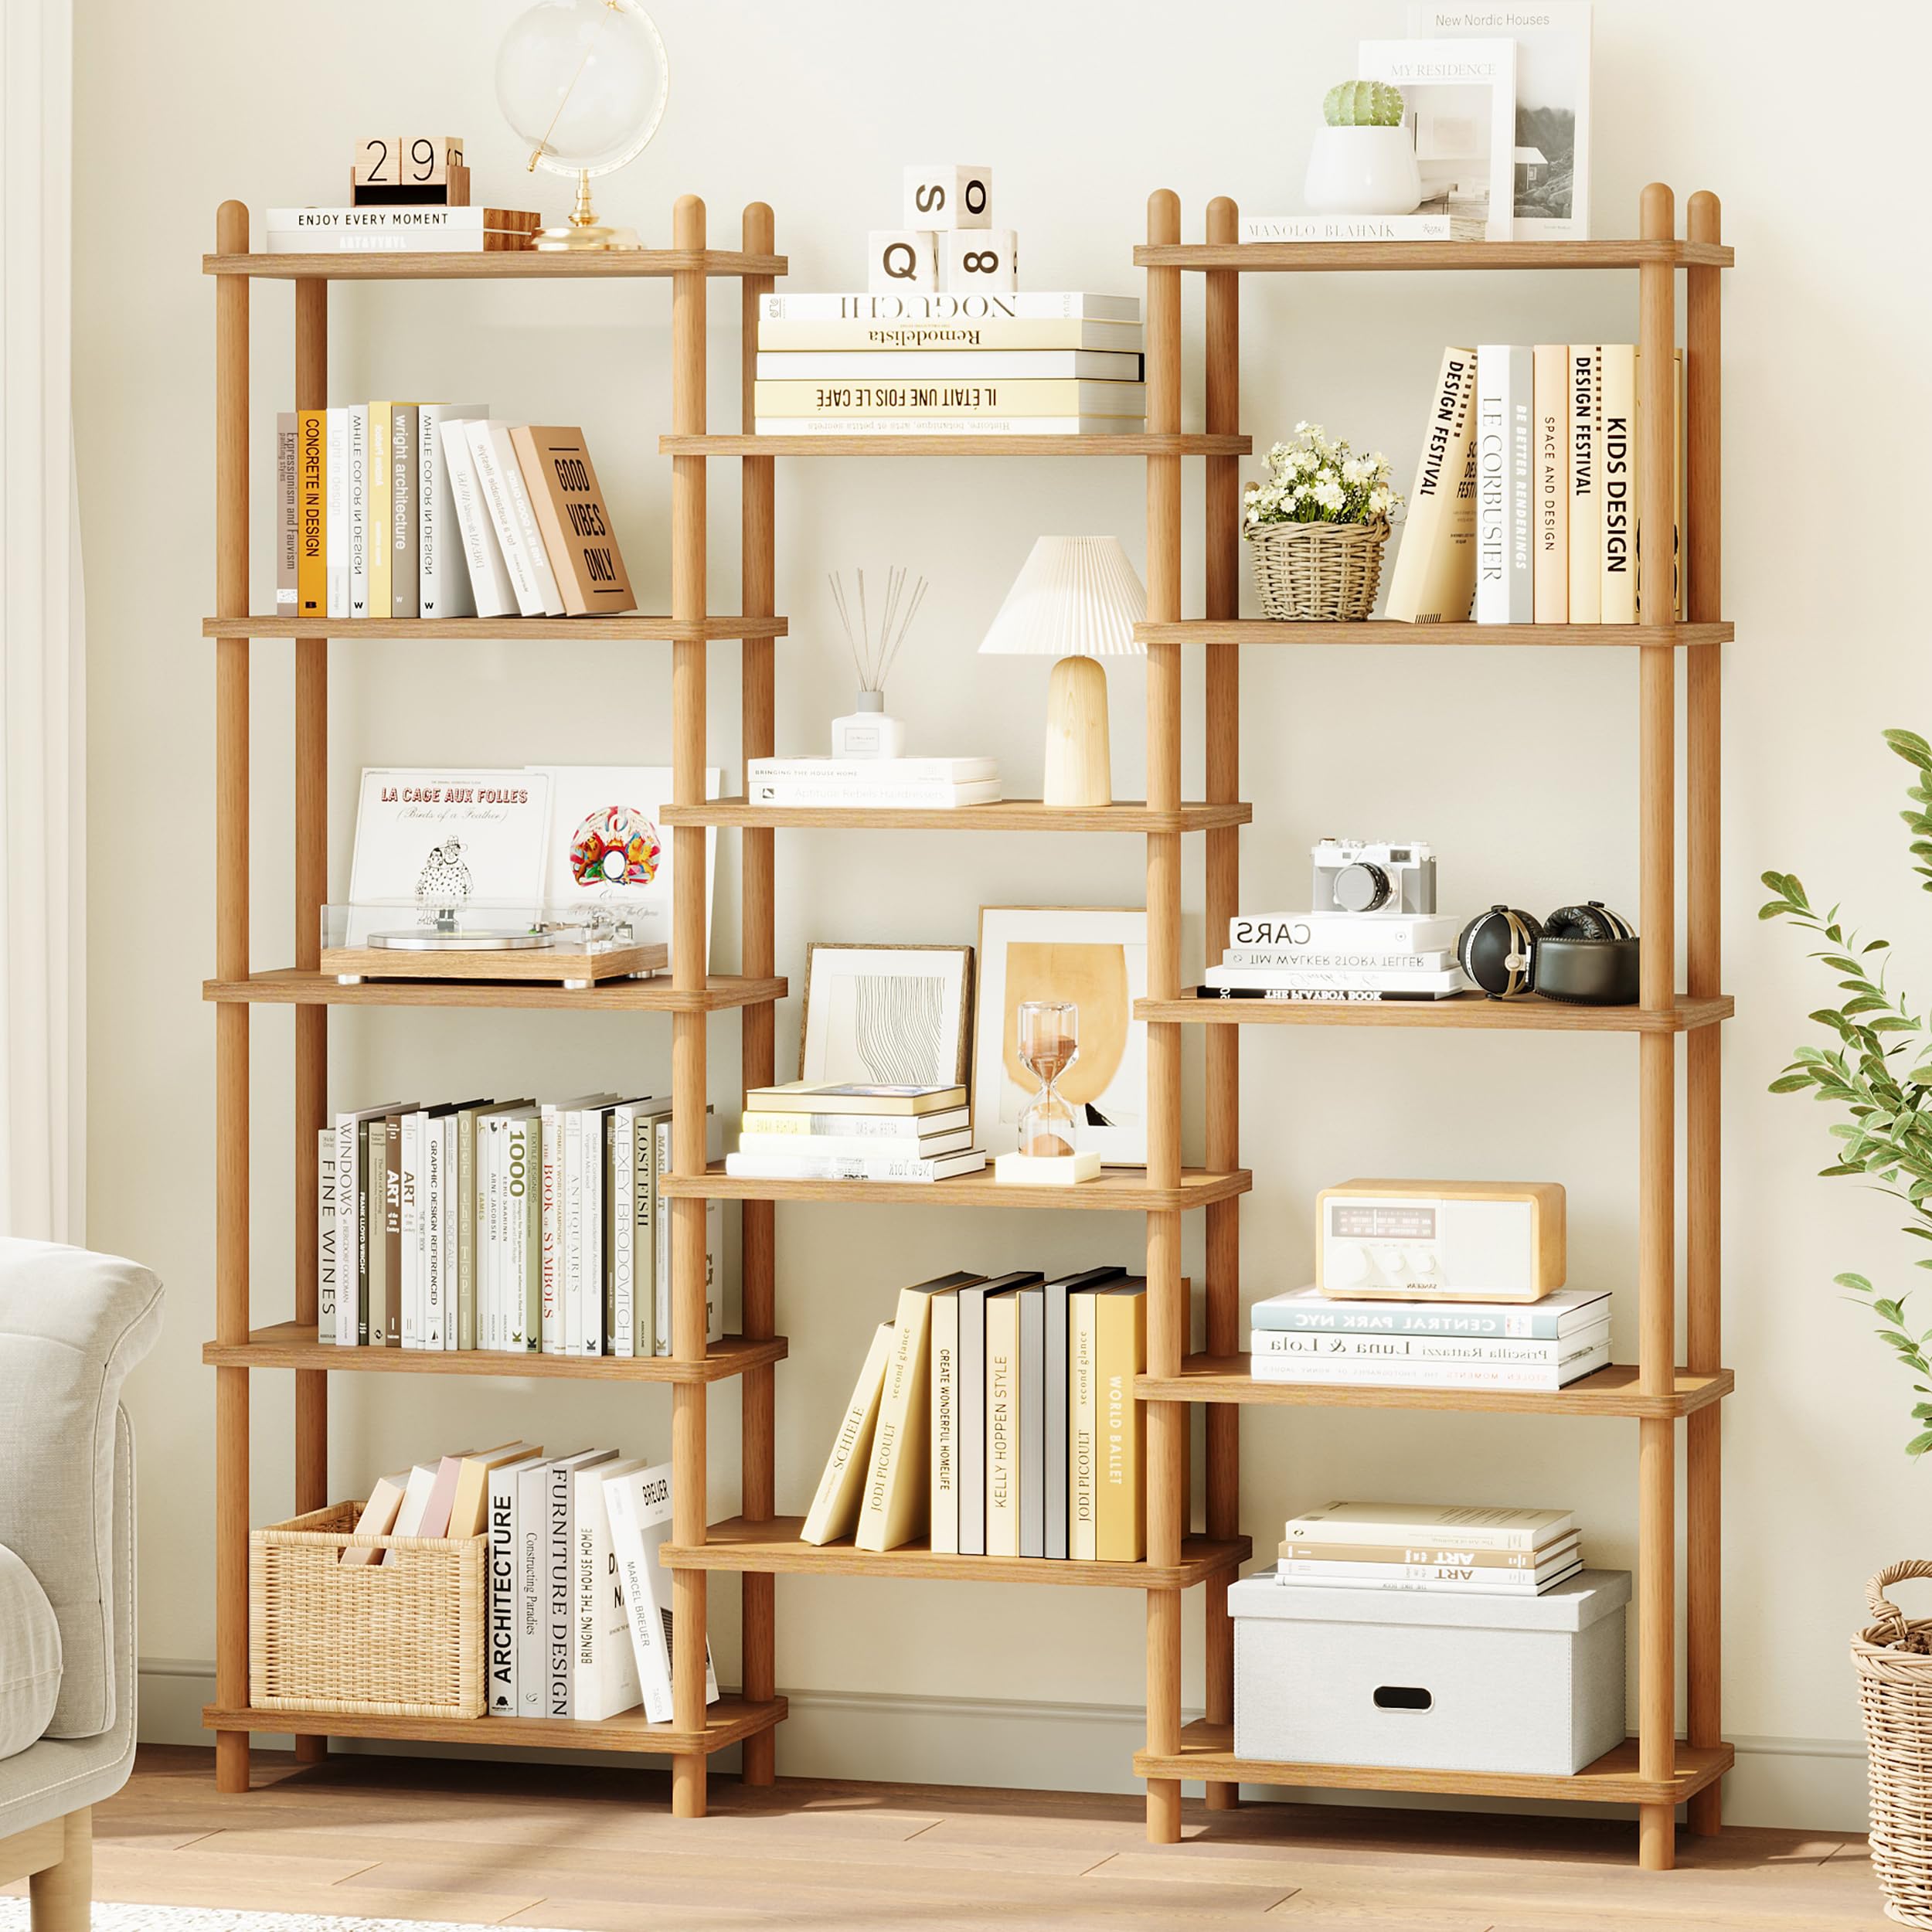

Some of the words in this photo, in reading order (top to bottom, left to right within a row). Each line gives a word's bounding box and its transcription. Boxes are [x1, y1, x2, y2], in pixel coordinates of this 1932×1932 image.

[1435, 14, 1461, 26] New
[1464, 13, 1503, 26] Nordic
[1506, 13, 1549, 26] Houses
[1391, 64, 1413, 76] MY
[1417, 63, 1497, 76] RESIDENCE
[298, 215, 339, 226] ENJOY
[345, 214, 386, 225] EVERY
[393, 213, 448, 225] MOMENT
[1248, 223, 1316, 238] MANOLO
[883, 243, 917, 281] Q
[841, 295, 1018, 318] NOGUCHI
[868, 330, 981, 345] Remodelista
[816, 389, 851, 410] CAFÉ
[855, 389, 871, 406] LE
[876, 389, 905, 406] FOIS
[911, 389, 937, 406] UNE
[942, 389, 980, 410] ÉTAIT
[985, 389, 997, 406] IL
[1437, 361, 1464, 421] DESIGN
[1576, 357, 1591, 417] DESIGN
[1483, 396, 1502, 427] LE
[1515, 405, 1527, 423] BE
[306, 419, 319, 490] CONCRETE
[395, 414, 406, 460] wright
[1515, 427, 1527, 476] BETTER
[1545, 417, 1555, 460] SPACE
[1607, 418, 1627, 474] KIDS
[286, 432, 295, 505] Expressionism
[554, 458, 590, 492] GOOD
[1420, 427, 1449, 496] FESTIVAL
[1545, 465, 1555, 494] AND
[1576, 425, 1591, 496] FESTIVAL
[287, 508, 295, 526] and
[306, 493, 319, 505] IN
[395, 464, 408, 550] architecture
[566, 502, 606, 536] VIBES
[1483, 434, 1502, 581] CORBUSIER
[306, 509, 319, 557] DESIGN
[1515, 480, 1527, 570] RENDERINGS
[1545, 501, 1555, 551] DESIGN
[1607, 481, 1627, 573] DESIGN
[286, 529, 298, 570] Fauvism
[583, 548, 616, 582] ONLY
[381, 787, 398, 802] LA
[403, 787, 440, 803] CAGE
[444, 787, 474, 804] AUX
[478, 788, 528, 804] FOLLES
[340, 1122, 352, 1216] WINDOWS
[509, 1131, 525, 1196] 1000
[617, 1114, 630, 1196] ALEXEY
[638, 1125, 648, 1177] LOST
[322, 1160, 335, 1216] FINE
[387, 1169, 399, 1206] ART
[404, 1172, 415, 1206] ART
[543, 1165, 553, 1212] BOOK
[638, 1182, 648, 1226] FISH
[570, 1175, 579, 1292] ANTIQUAIRES
[322, 1230, 335, 1315] WINES
[543, 1232, 553, 1318] SYMBOLS
[617, 1204, 630, 1340] BRODOVITCH
[893, 1364, 903, 1399] second
[900, 1328, 910, 1361] glance
[940, 1349, 950, 1385] CREATE
[1079, 1332, 1090, 1365] glance
[995, 1355, 1007, 1397] STYLE
[1079, 1366, 1087, 1405] second
[940, 1387, 950, 1444] WONDERFUL
[1109, 1376, 1122, 1429] WORLD
[832, 1406, 864, 1470] SCHIELE
[876, 1422, 895, 1479] PICOULT
[995, 1403, 1007, 1461] HOPPEN
[940, 1445, 950, 1491] HOMELIFE
[1078, 1429, 1090, 1485] PICOULT
[1109, 1435, 1122, 1485] BALLET
[642, 1478, 668, 1506] BREUER
[871, 1481, 886, 1512] JODI
[995, 1464, 1007, 1508] KELLY
[1078, 1488, 1091, 1522] JODI
[524, 1532, 538, 1594] Constructing
[553, 1469, 567, 1615] FURNITURE
[581, 1528, 592, 1556] HOME
[1434, 1552, 1475, 1565] ART
[494, 1495, 512, 1684] ARCHITECTURE
[581, 1559, 592, 1592] HOUSE
[1434, 1569, 1474, 1580] ART
[526, 1596, 538, 1635] Paradies
[581, 1594, 592, 1614] THE
[626, 1561, 642, 1603] MARCEL
[634, 1605, 650, 1648] BREUER
[581, 1617, 592, 1664] BRINGING
[553, 1624, 567, 1716] DESIGN
